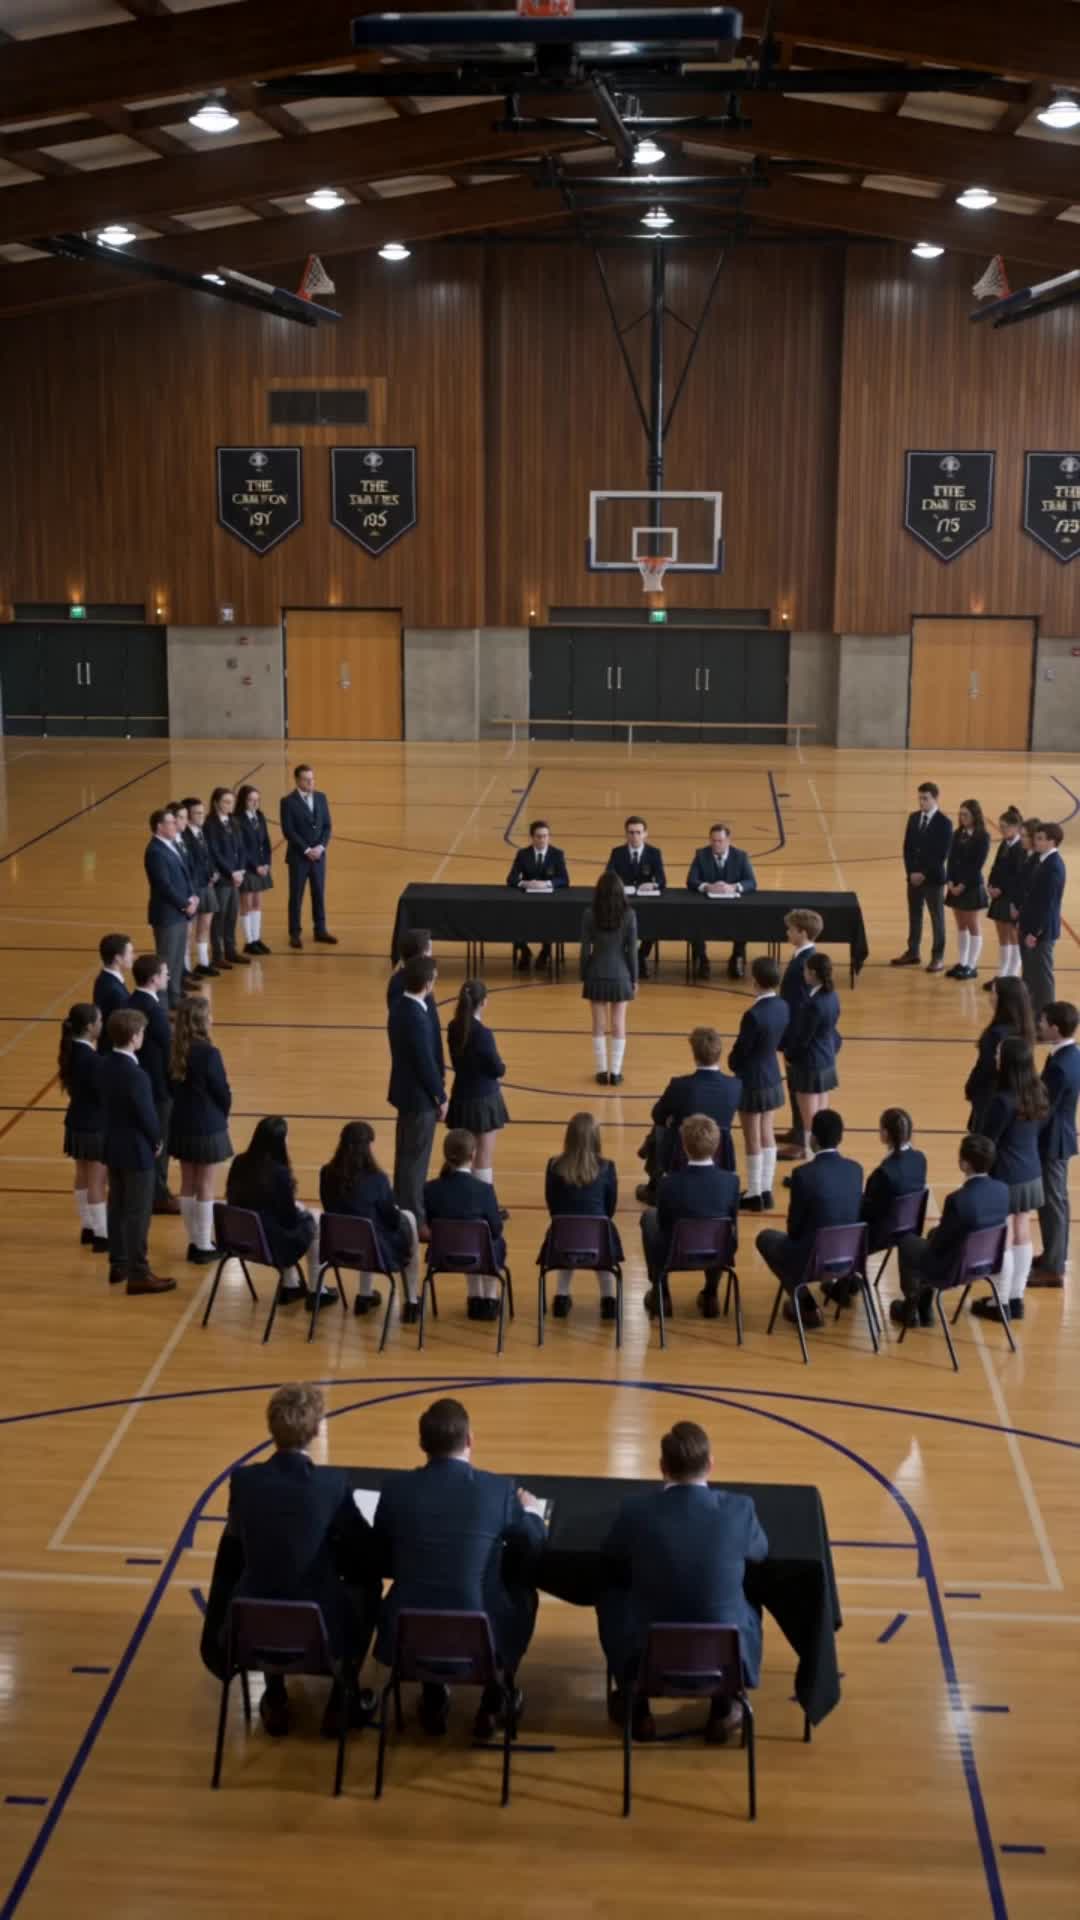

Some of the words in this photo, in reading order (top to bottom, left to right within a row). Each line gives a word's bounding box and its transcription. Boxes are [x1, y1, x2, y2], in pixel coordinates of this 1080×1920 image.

[245, 479, 273, 492] THE
[360, 479, 389, 493] THE
[933, 485, 966, 497] THE
